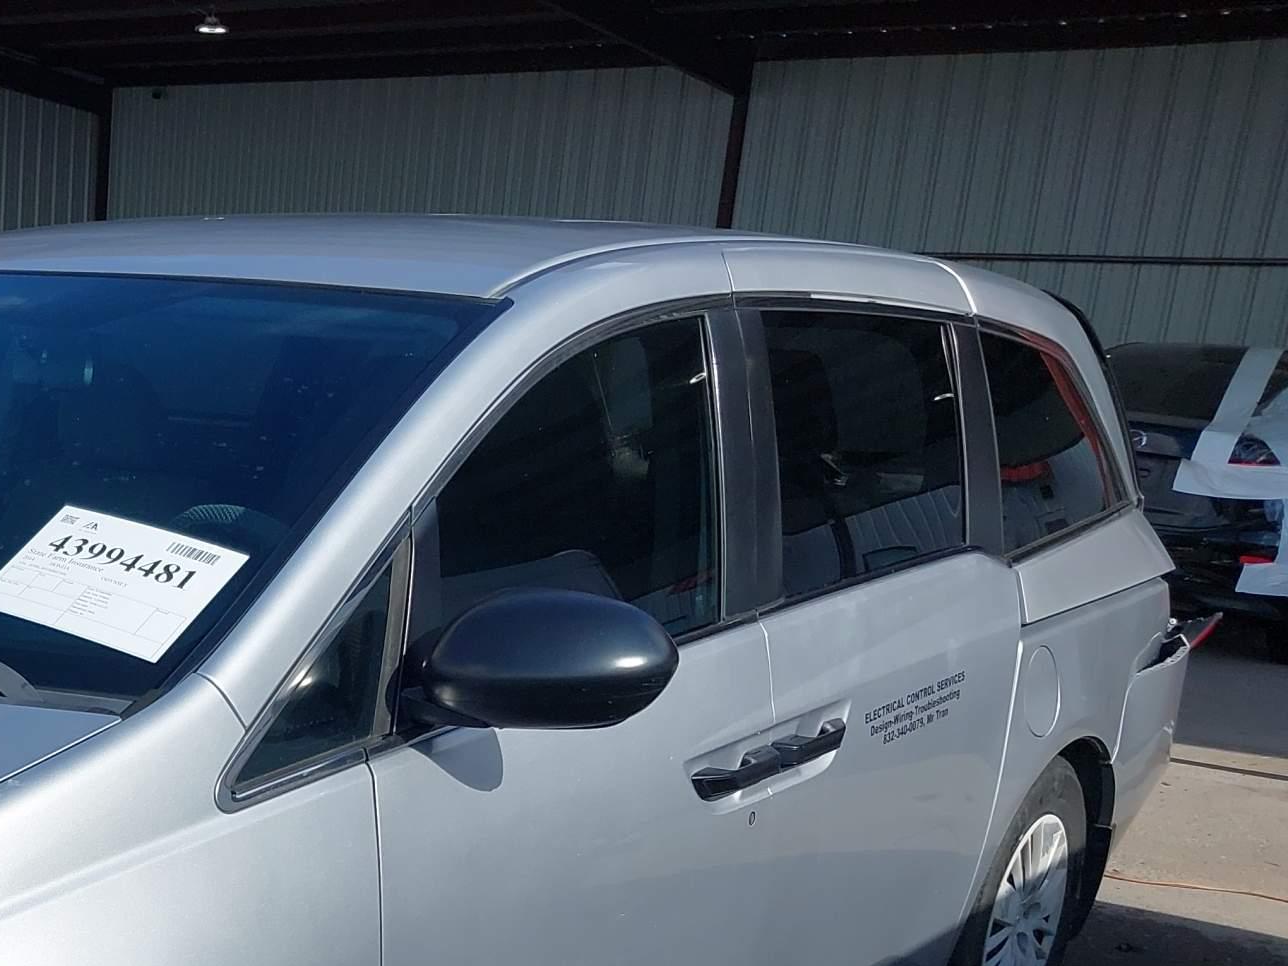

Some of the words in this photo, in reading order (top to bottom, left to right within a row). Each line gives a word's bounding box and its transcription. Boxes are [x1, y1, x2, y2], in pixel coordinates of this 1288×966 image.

[47, 552, 67, 563] Farm
[48, 534, 198, 591] 43994481
[864, 697, 905, 724] ELECTRICAL
[906, 685, 936, 706] CONTROL
[936, 670, 966, 692] SERVICES
